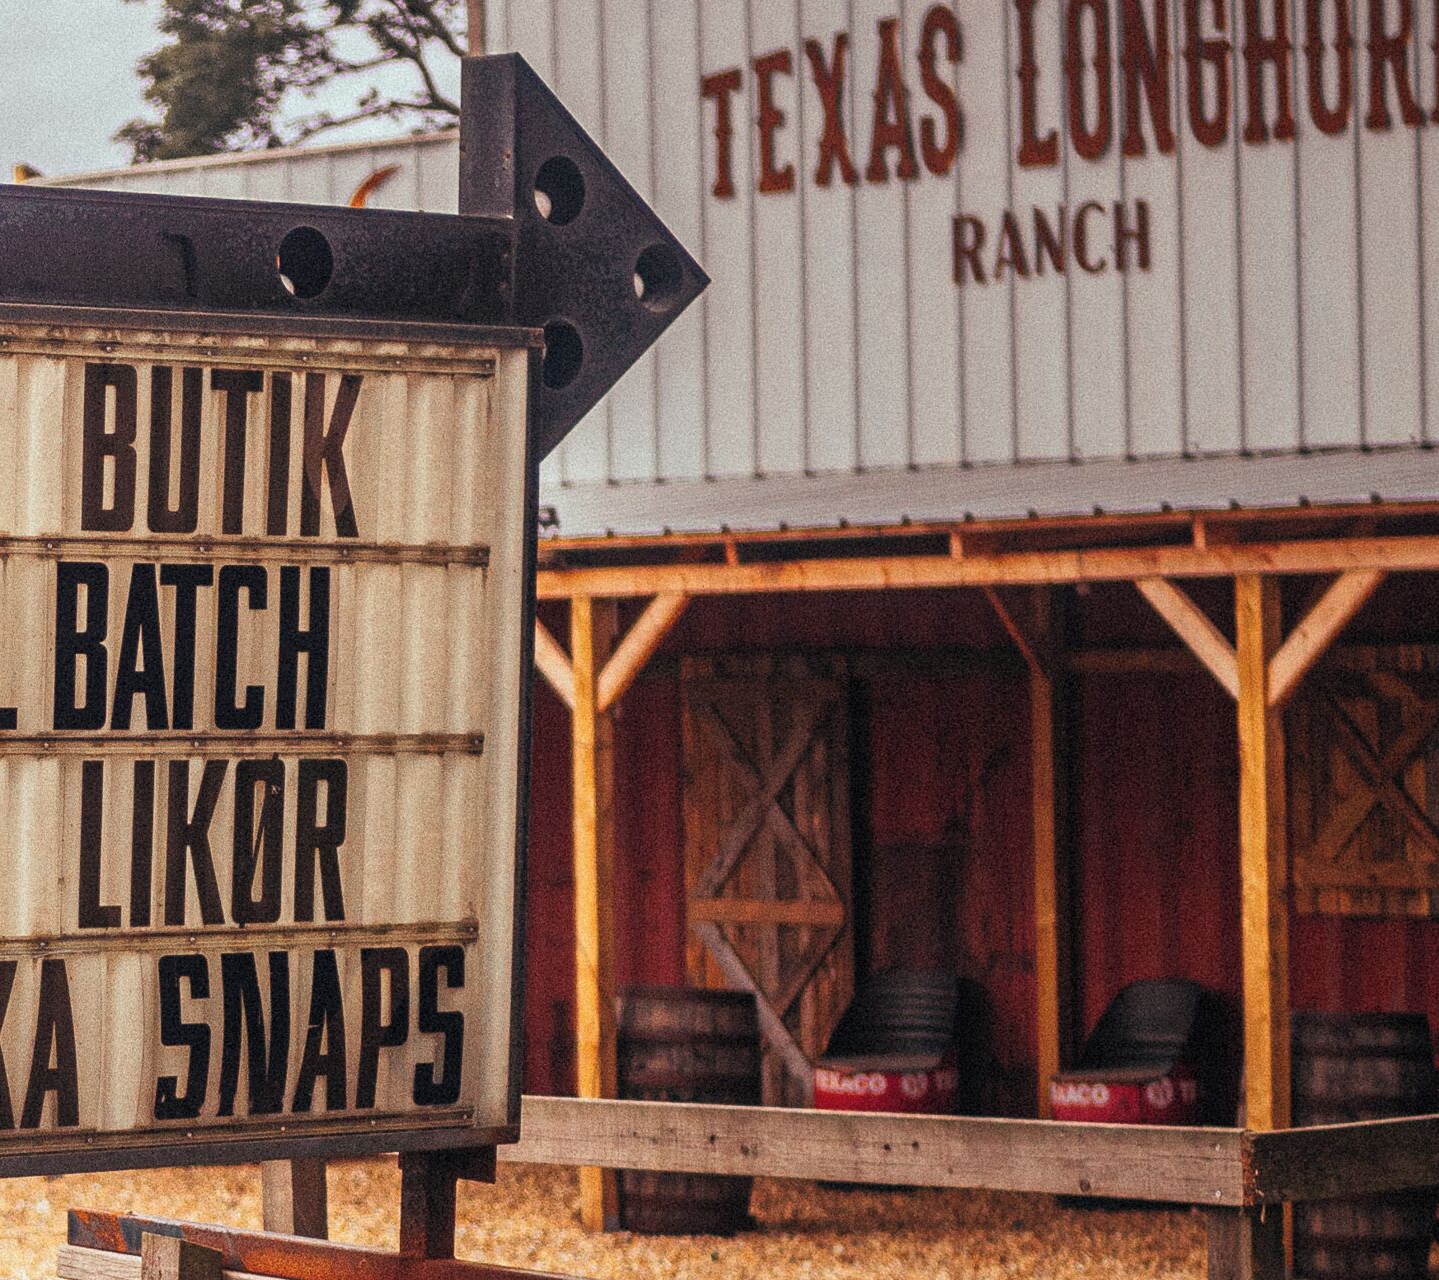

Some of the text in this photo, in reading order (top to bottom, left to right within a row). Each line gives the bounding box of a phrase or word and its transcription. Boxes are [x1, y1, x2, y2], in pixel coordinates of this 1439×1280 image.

[700, 4, 963, 199] TEXAS
[951, 200, 1152, 287] RANCH
[80, 362, 362, 538] BUTIK
[53, 561, 331, 731] BATCH
[78, 754, 348, 929] LIKØR
[155, 944, 466, 1120] SNAPS
